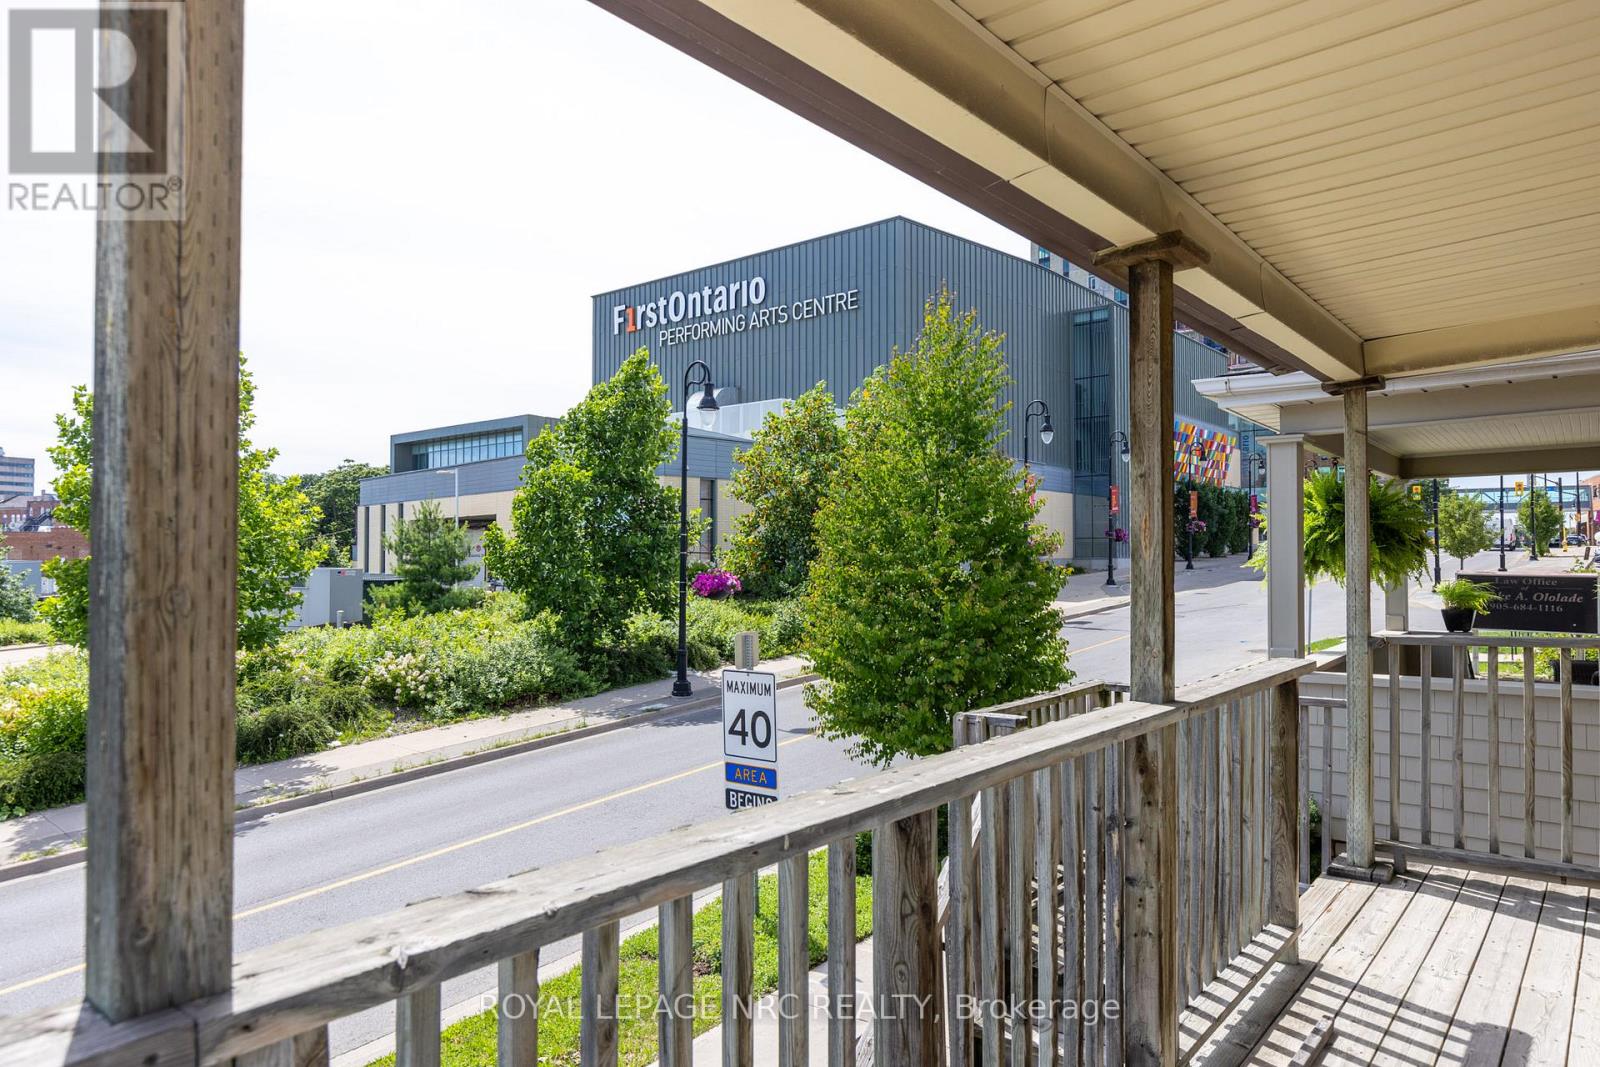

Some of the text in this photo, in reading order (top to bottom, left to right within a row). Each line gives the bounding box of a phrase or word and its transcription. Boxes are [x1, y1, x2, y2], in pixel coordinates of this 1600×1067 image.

[659, 289, 859, 347] PERFORMING ARTS CENTRE
[1522, 577, 1558, 586] Office
[1532, 592, 1584, 603] Ololade
[726, 680, 772, 697] MAXIMUM
[728, 708, 772, 749] 40
[734, 767, 768, 785] AREA
